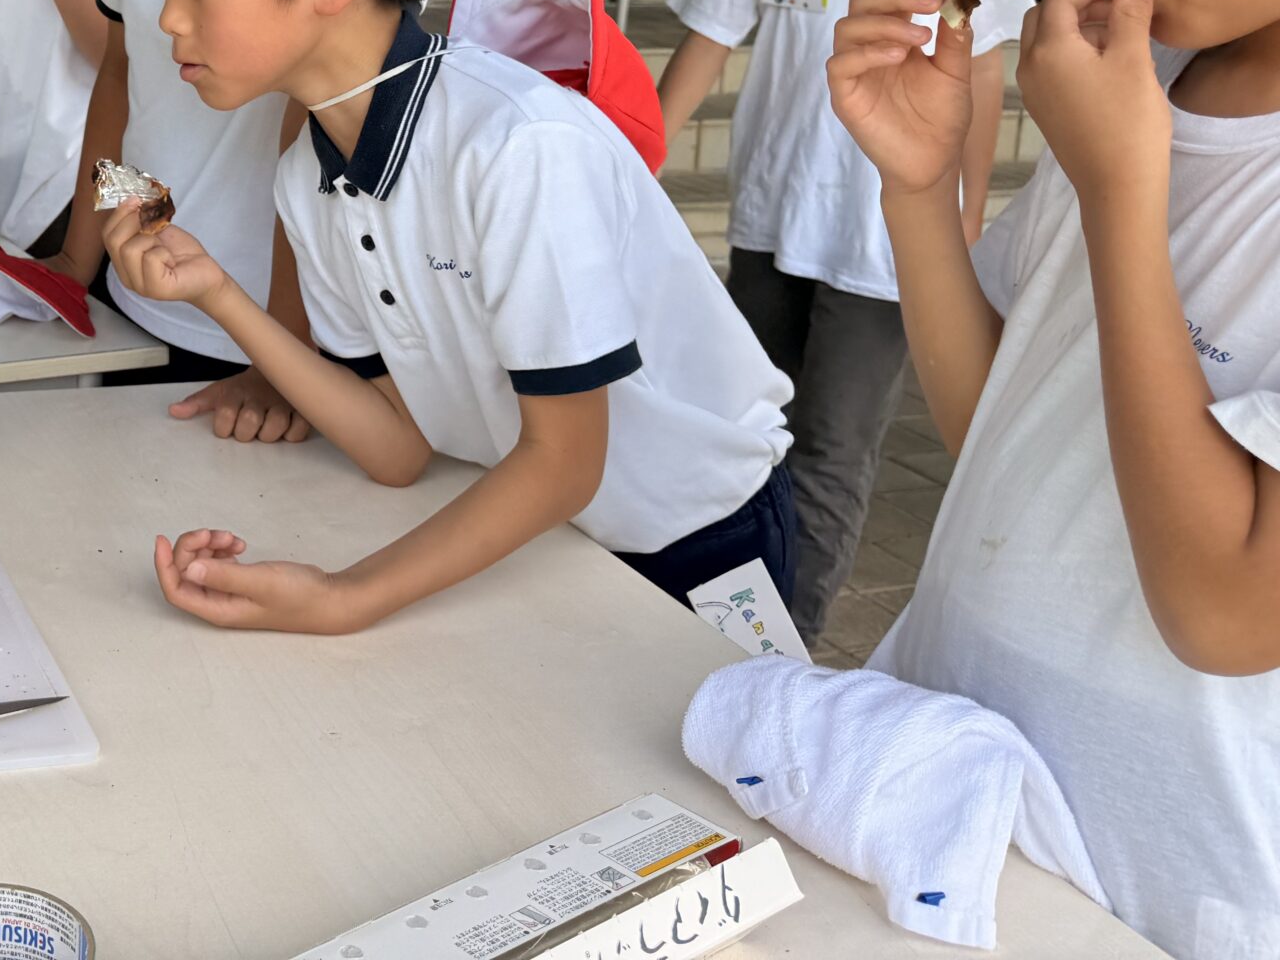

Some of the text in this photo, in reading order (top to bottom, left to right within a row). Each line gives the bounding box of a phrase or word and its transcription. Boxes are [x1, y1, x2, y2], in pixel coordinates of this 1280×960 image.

[598, 864, 741, 960] ダイアラッ
[2, 918, 23, 927] JAPAN
[31, 922, 49, 935] MADE
